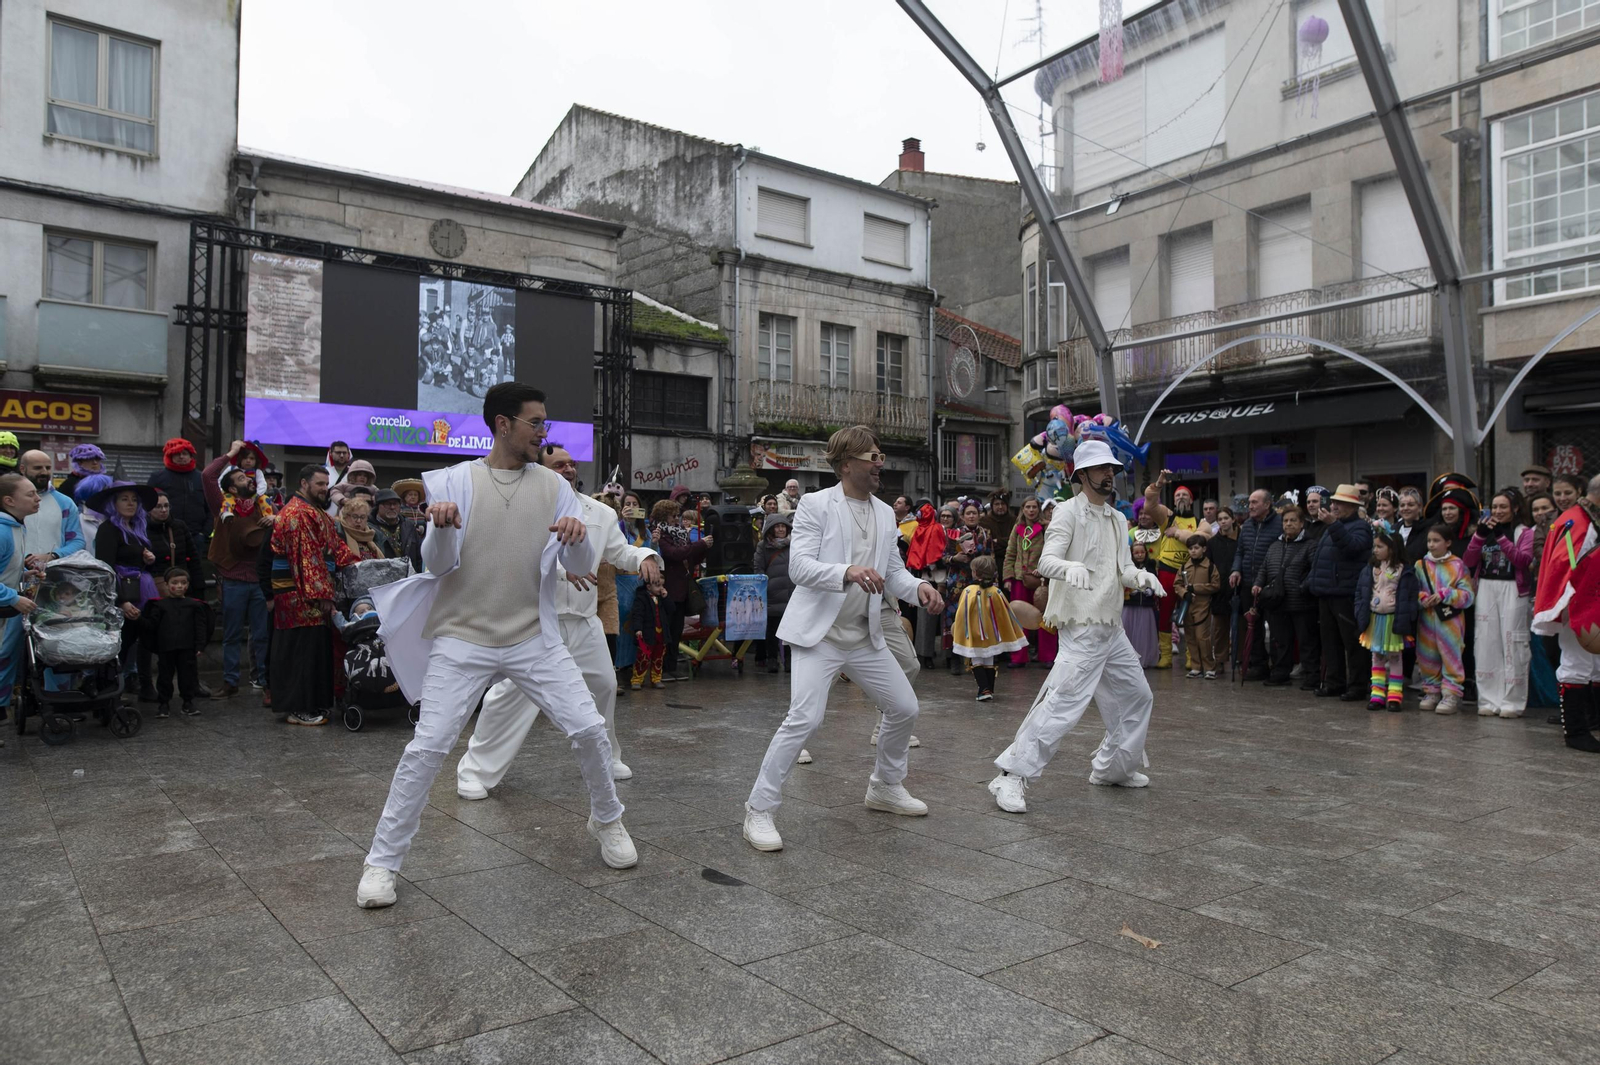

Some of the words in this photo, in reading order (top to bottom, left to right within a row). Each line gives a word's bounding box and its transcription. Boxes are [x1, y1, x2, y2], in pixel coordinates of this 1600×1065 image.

[1, 399, 93, 422] ACOS
[370, 415, 411, 428] concello
[366, 424, 430, 446] XINZO
[634, 457, 699, 484] Requinto
